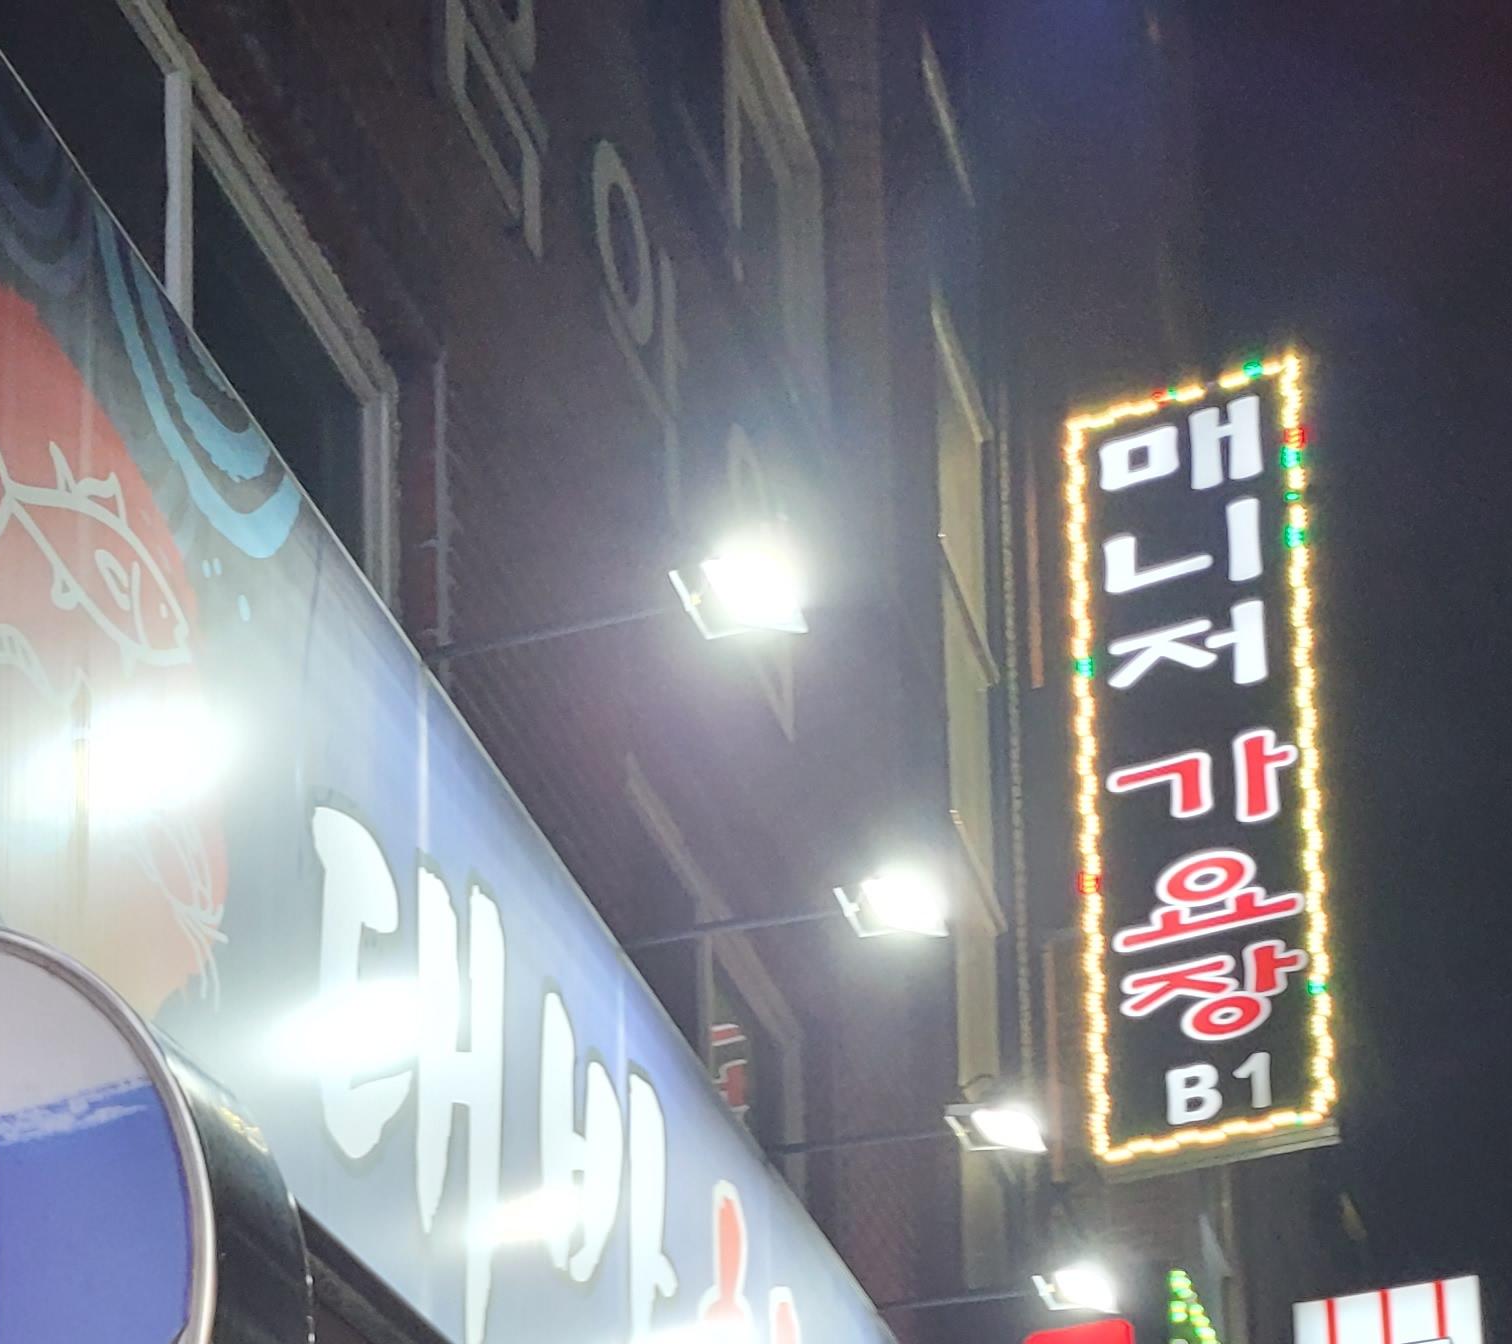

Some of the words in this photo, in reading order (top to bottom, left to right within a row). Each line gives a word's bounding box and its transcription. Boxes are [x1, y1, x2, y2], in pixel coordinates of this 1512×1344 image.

[1099, 396, 1269, 688] 매니저
[1106, 728, 1308, 1041] 가요장
[1164, 1052, 1273, 1127] B1
